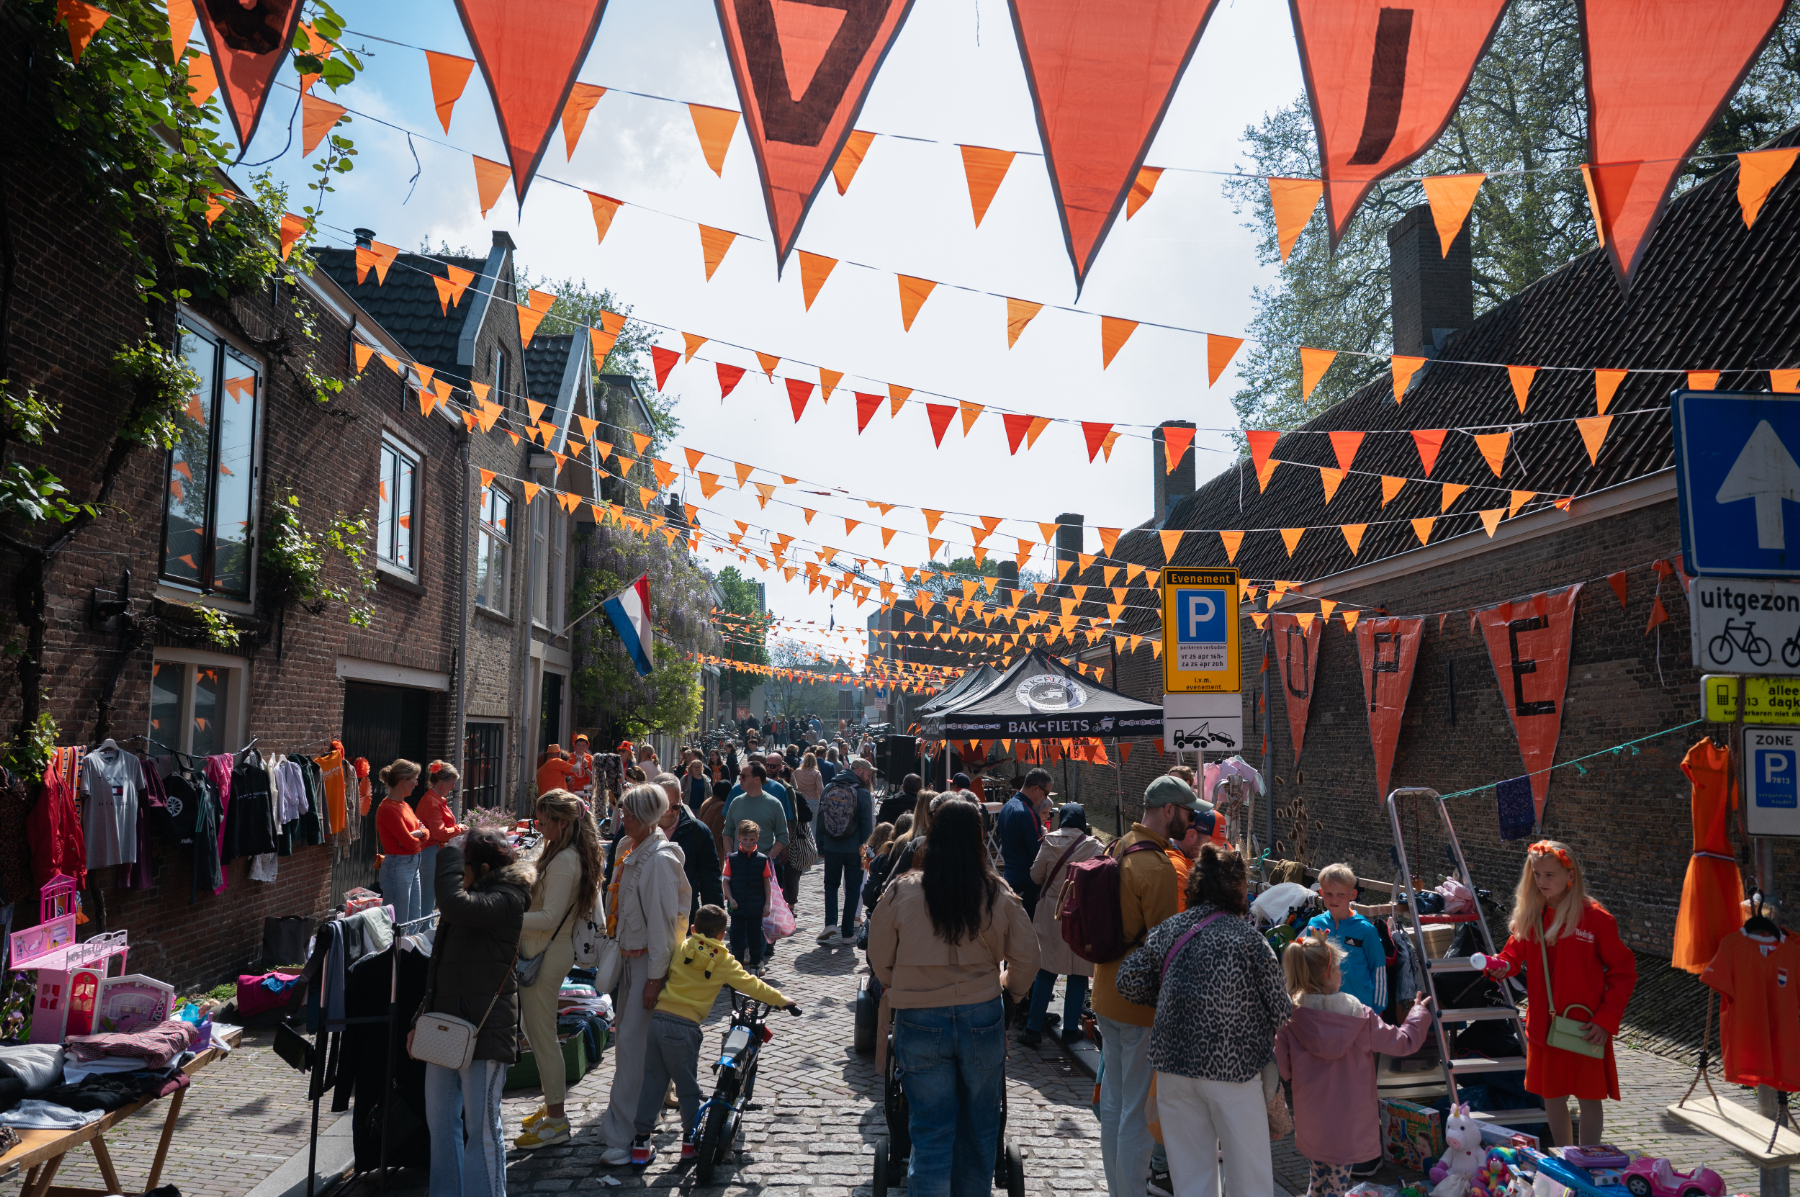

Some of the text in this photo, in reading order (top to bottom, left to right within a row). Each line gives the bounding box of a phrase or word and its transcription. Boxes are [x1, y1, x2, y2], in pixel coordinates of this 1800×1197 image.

[1171, 573, 1231, 584] Evenement
[1700, 586, 1800, 617] uitgezon
[1188, 596, 1216, 638] P
[1197, 653, 1209, 661] apr
[1199, 661, 1211, 669] apr
[1508, 614, 1556, 717] E
[1370, 632, 1402, 713] P
[1731, 696, 1759, 707] 713
[1774, 710, 1790, 718] niet
[1008, 719, 1090, 733] BAK-FIETS
[1755, 734, 1794, 746] ZONE
[1764, 752, 1788, 783] P
[1771, 776, 1790, 784] 7813
